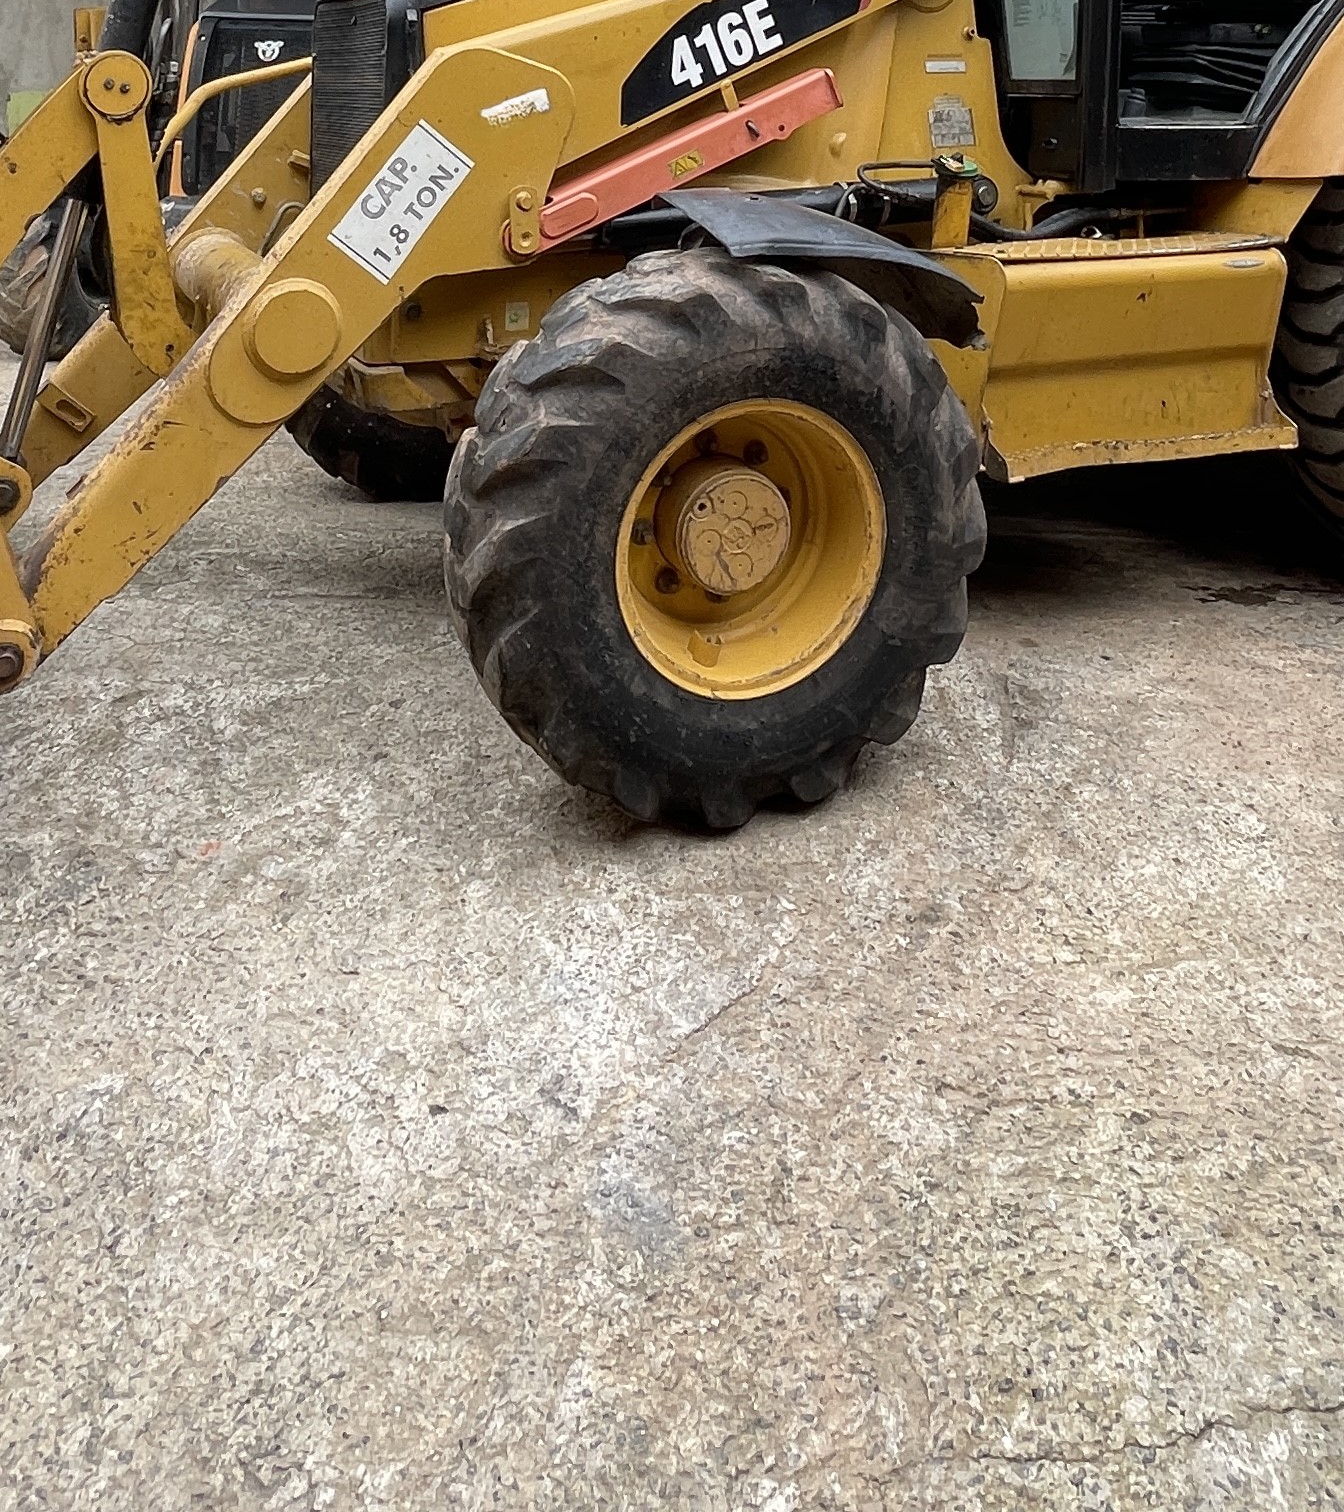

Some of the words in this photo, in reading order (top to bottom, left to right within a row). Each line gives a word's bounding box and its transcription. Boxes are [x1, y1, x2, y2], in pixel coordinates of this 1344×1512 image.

[360, 156, 417, 219] CAP.
[373, 223, 410, 262] 1,8
[403, 164, 459, 220] TON.
